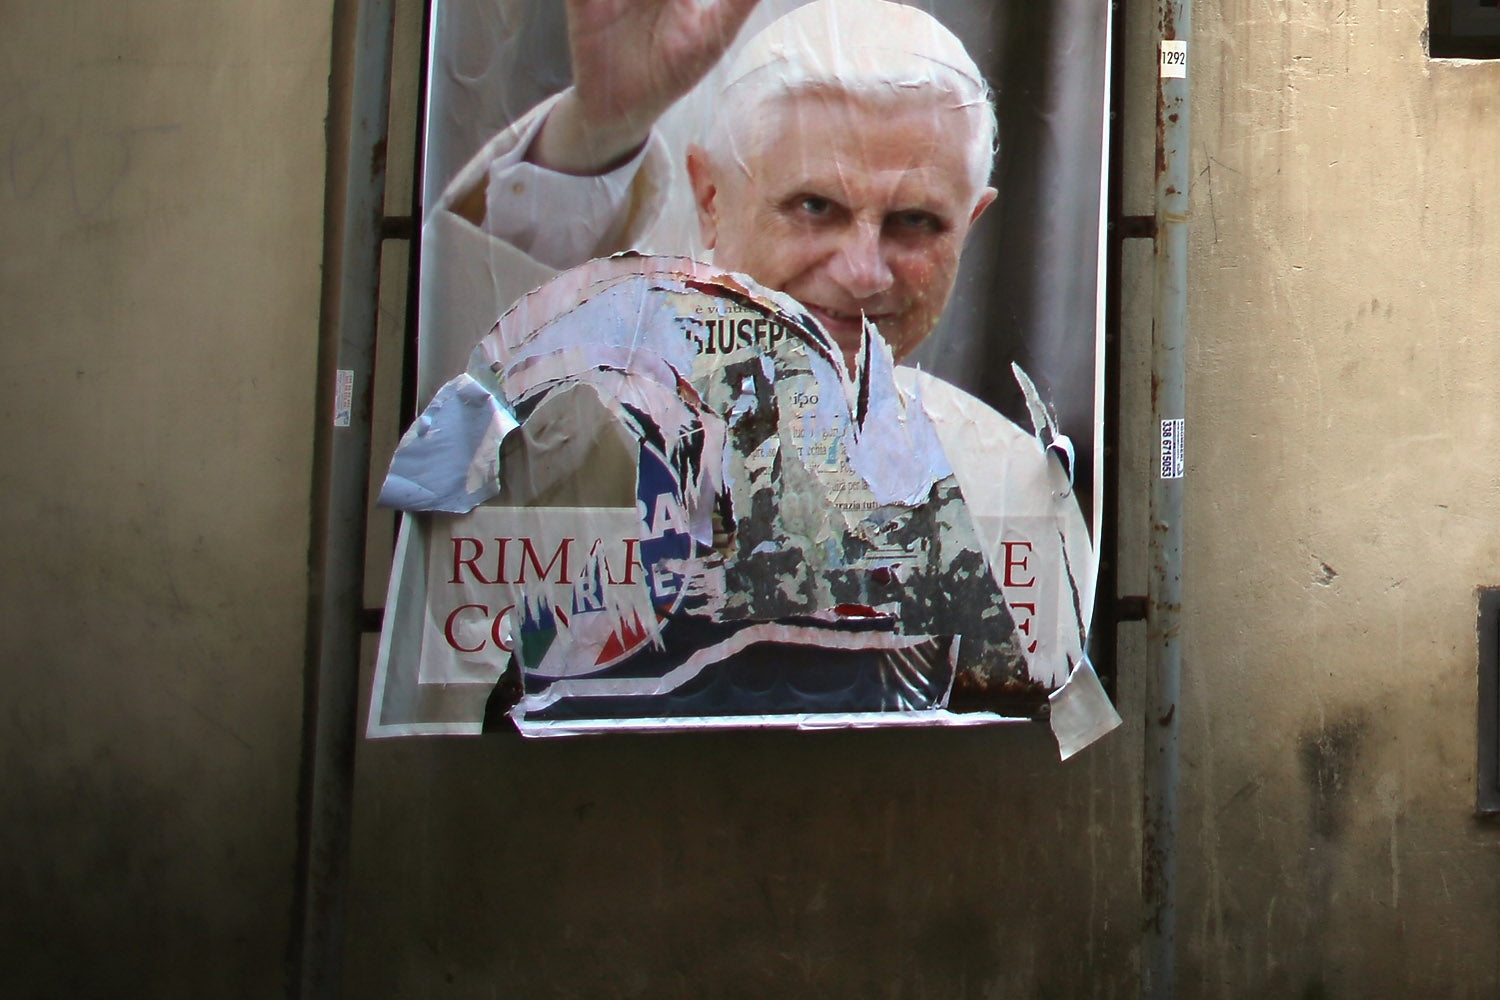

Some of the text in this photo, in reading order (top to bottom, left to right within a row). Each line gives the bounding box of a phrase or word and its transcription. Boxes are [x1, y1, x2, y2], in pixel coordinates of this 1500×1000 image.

[1162, 51, 1185, 65] 1292
[1162, 421, 1172, 477] 338 6715053
